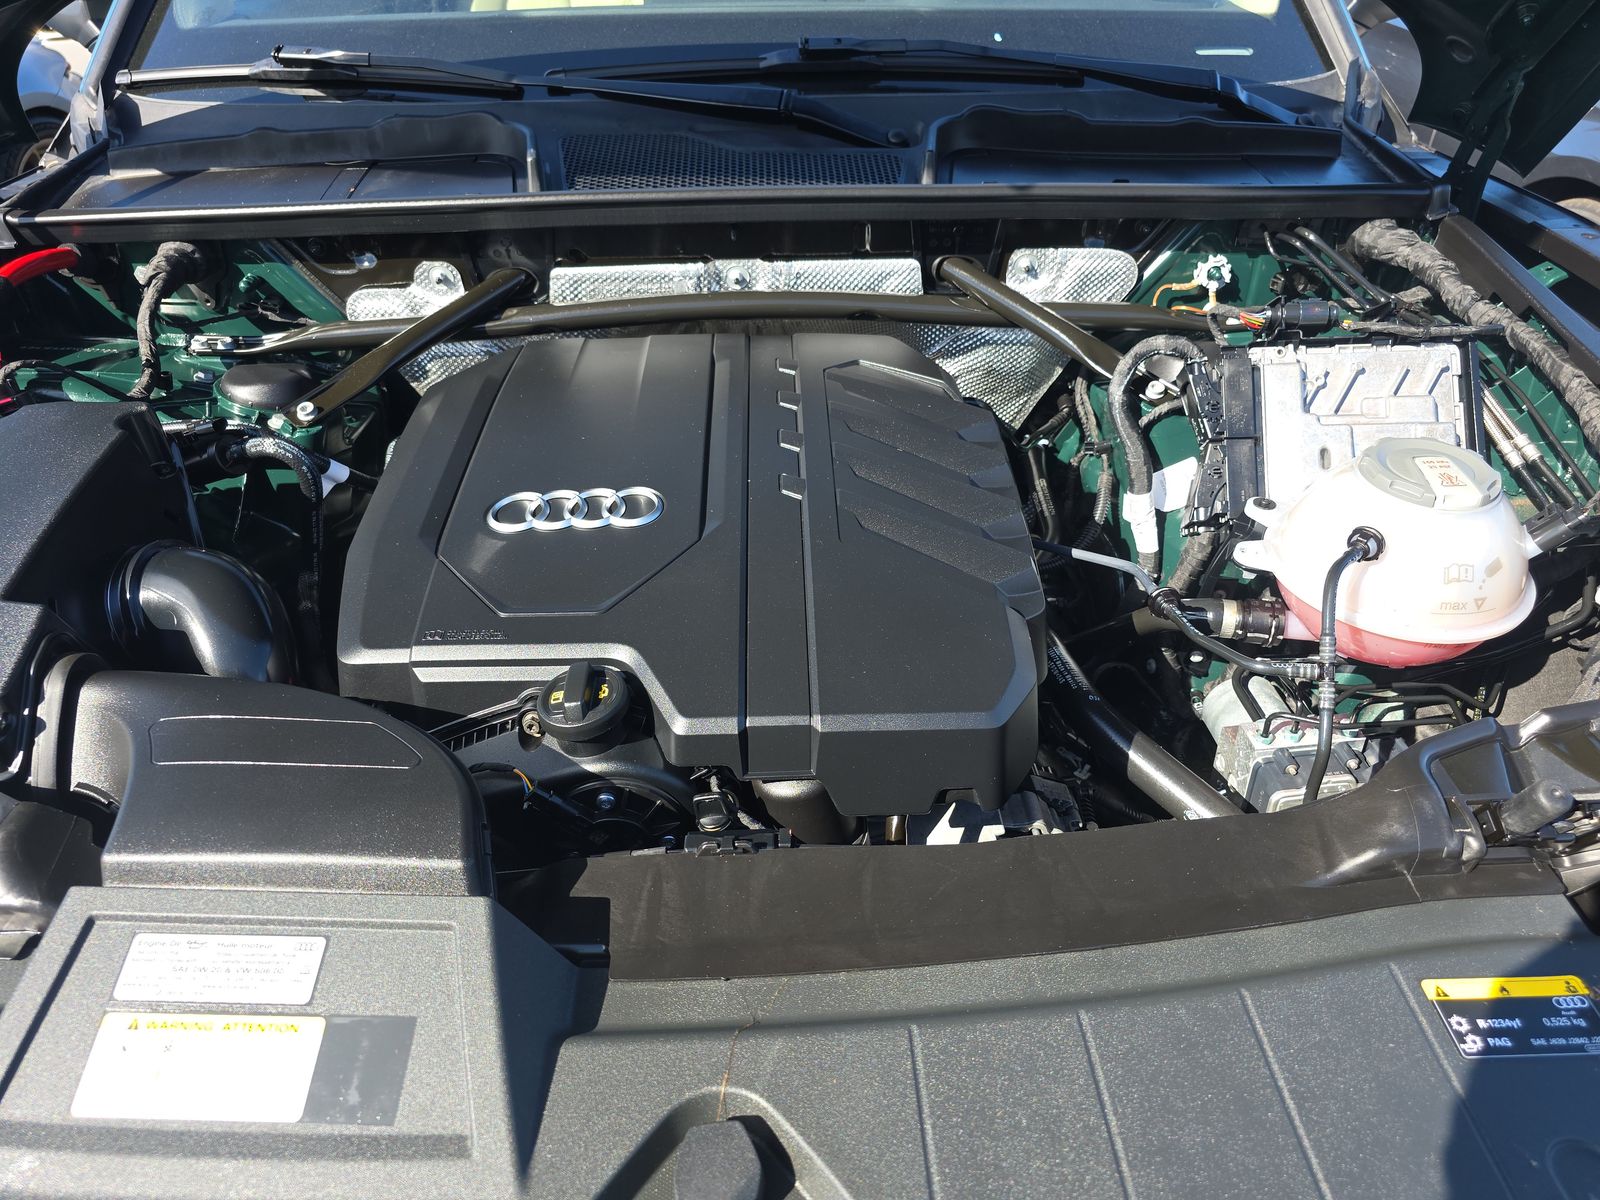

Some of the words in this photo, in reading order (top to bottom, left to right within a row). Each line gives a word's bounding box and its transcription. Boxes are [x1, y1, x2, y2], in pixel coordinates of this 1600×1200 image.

[1440, 602, 1468, 610] max
[145, 1020, 214, 1032] WARNING
[221, 1022, 300, 1034] ATTENTION
[1571, 1016, 1587, 1028] kg
[1486, 1037, 1512, 1047] PAG
